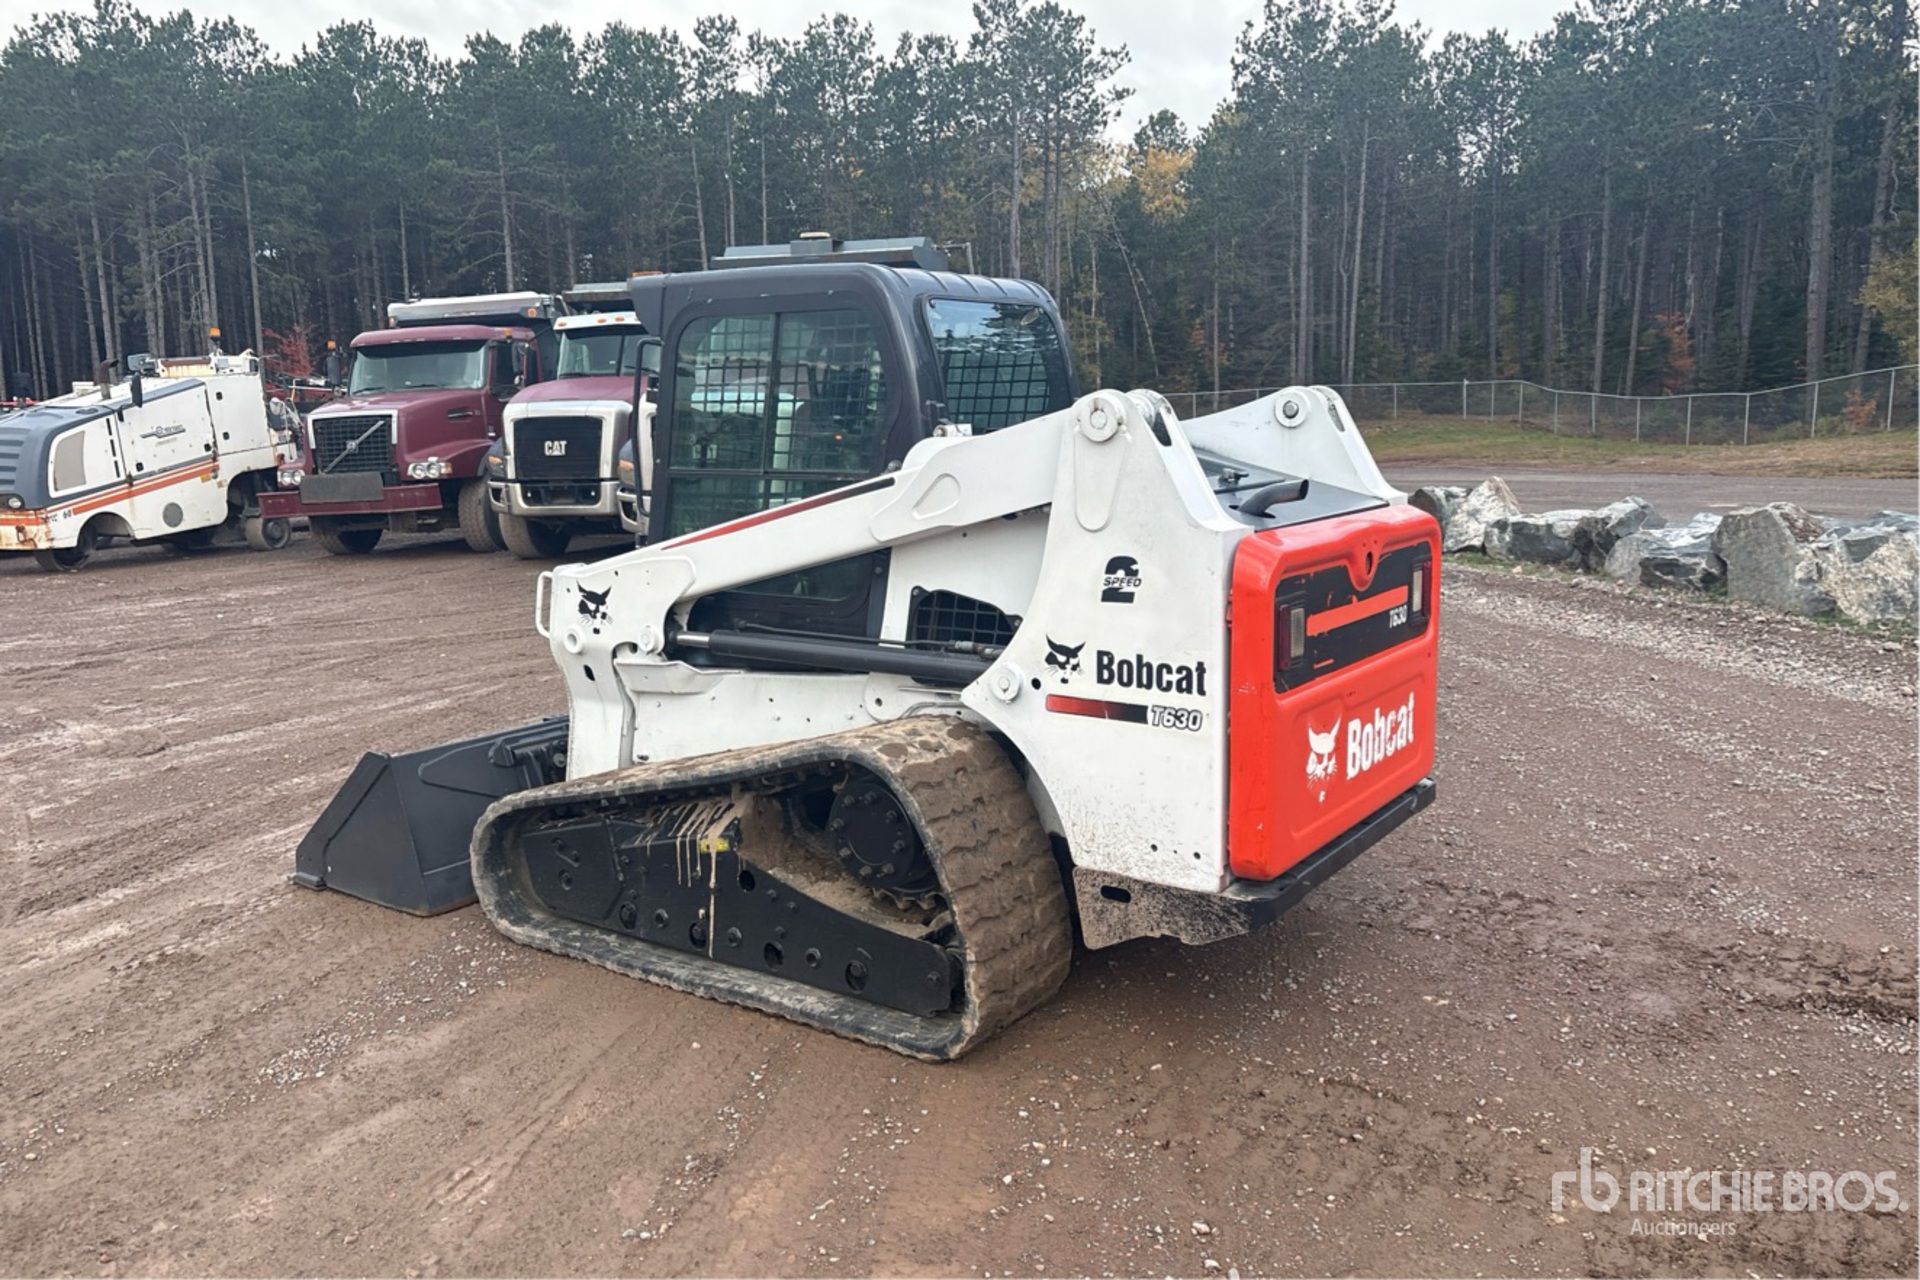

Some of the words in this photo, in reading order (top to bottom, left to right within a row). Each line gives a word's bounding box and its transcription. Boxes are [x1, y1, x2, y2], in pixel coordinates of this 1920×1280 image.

[544, 440, 568, 456] CAT
[1101, 555, 1139, 603] 2
[1103, 577, 1142, 588] SPEED
[1389, 604, 1408, 628] T630
[1096, 650, 1207, 696] Bobcat
[1150, 705, 1204, 732] T630
[1346, 691, 1415, 780] Bobcat
